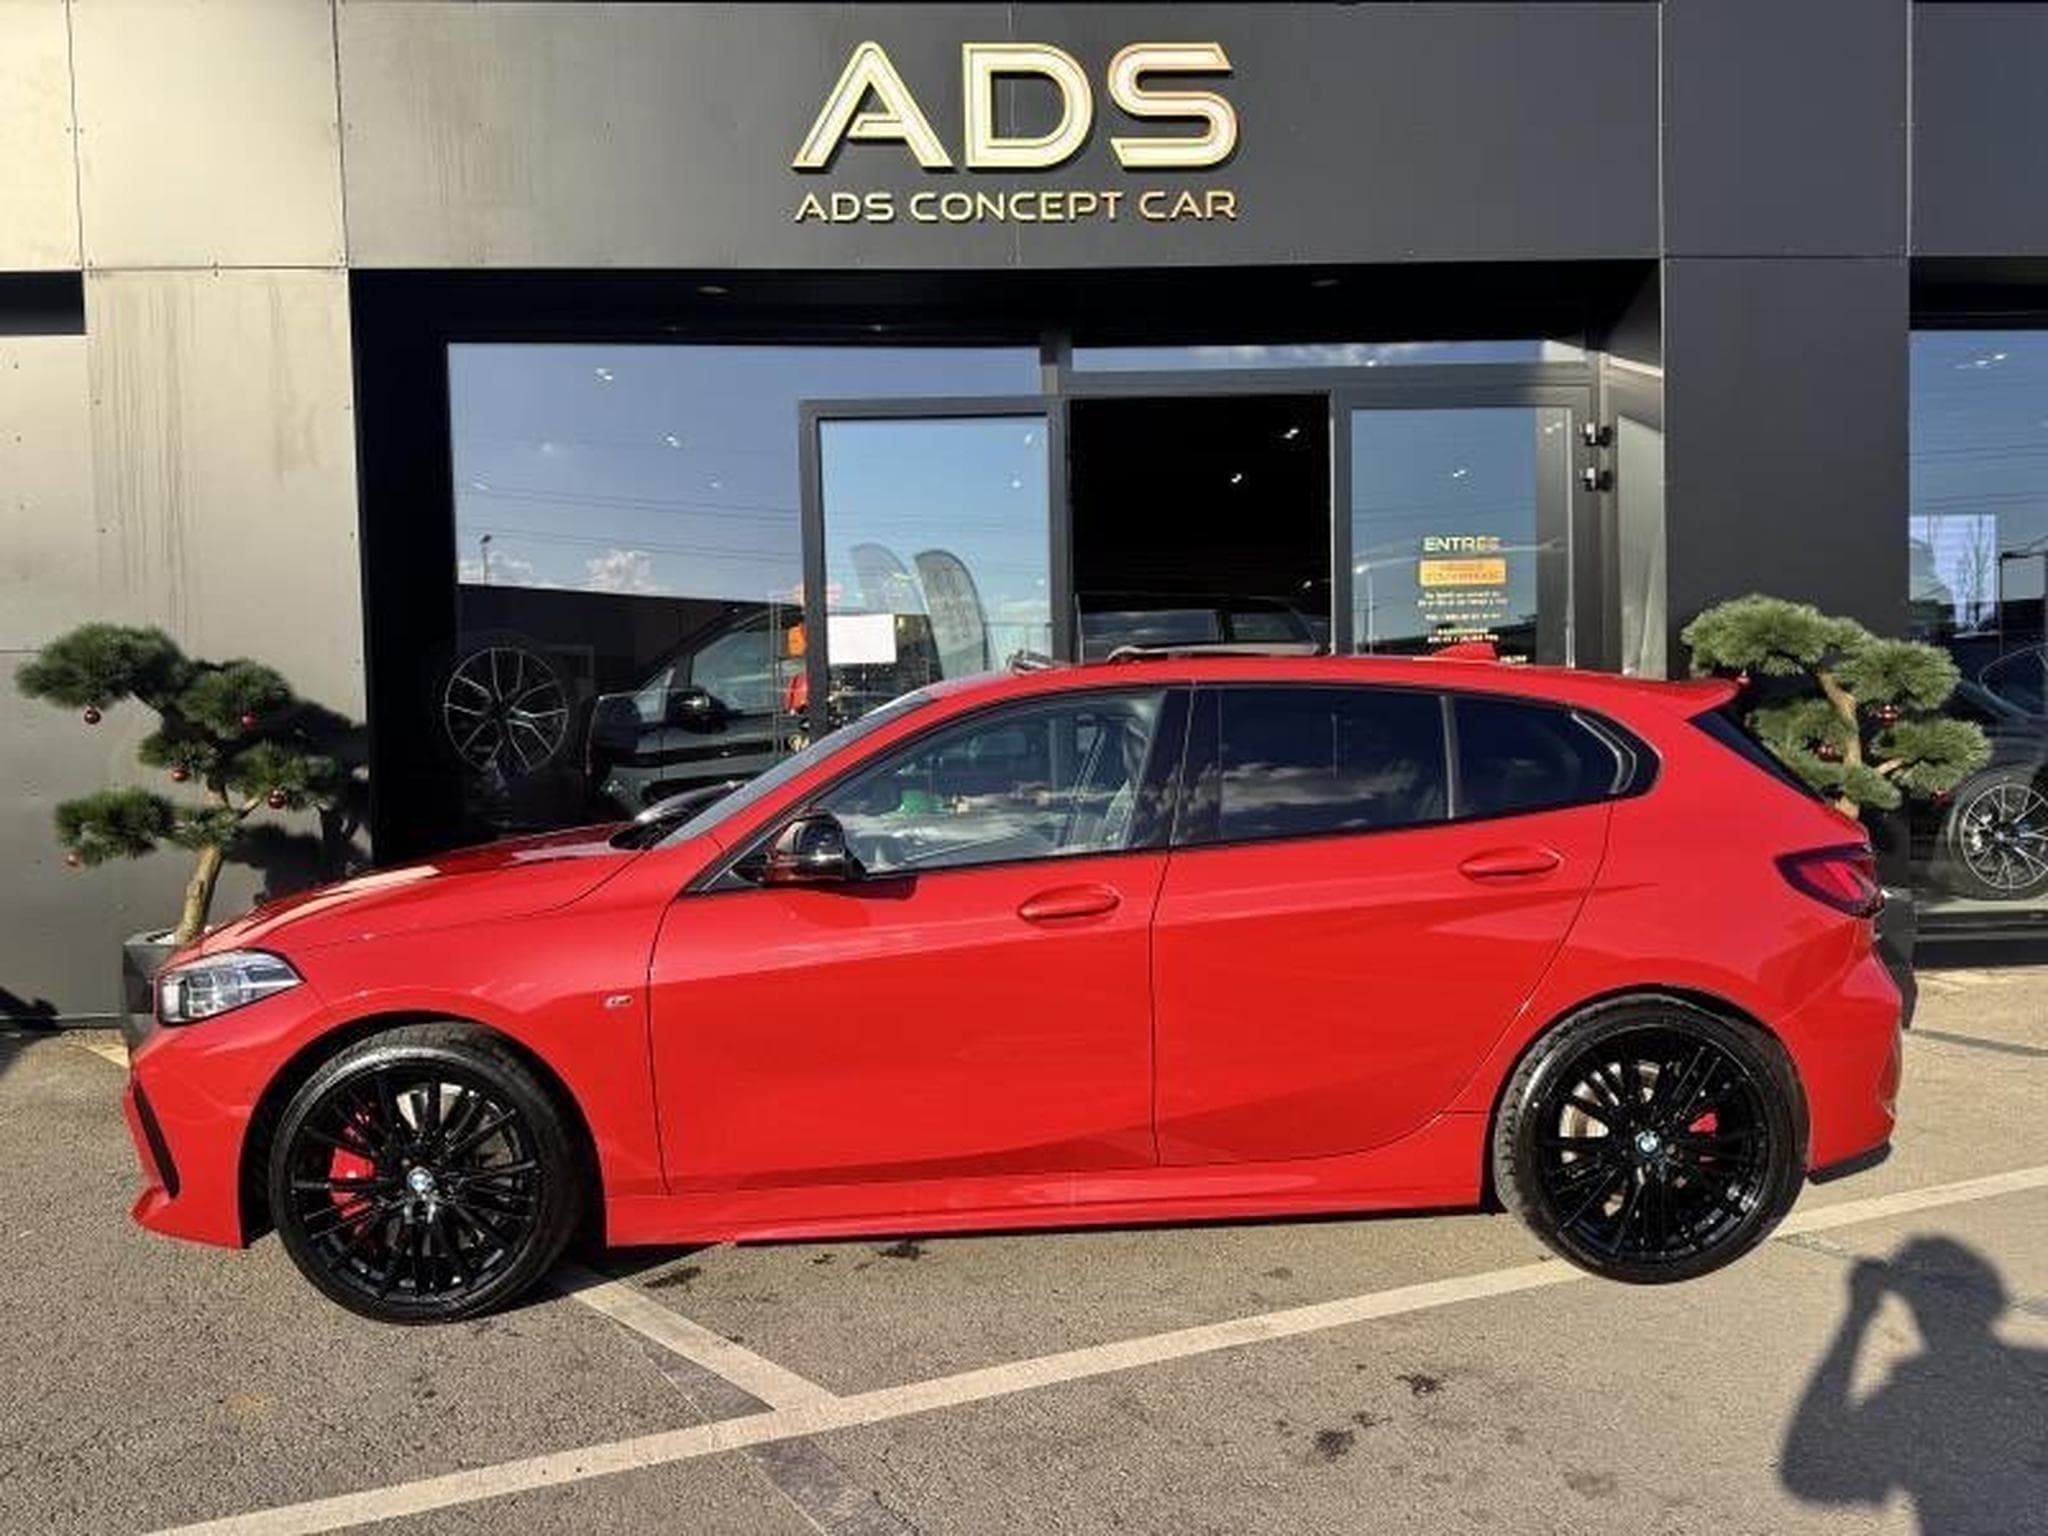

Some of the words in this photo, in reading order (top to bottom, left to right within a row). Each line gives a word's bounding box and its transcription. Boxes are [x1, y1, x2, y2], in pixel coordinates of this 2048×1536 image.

[792, 41, 1237, 167] ADS
[795, 191, 895, 221] ADS
[910, 191, 1124, 221] CONCEPT
[1138, 190, 1237, 220] CAR
